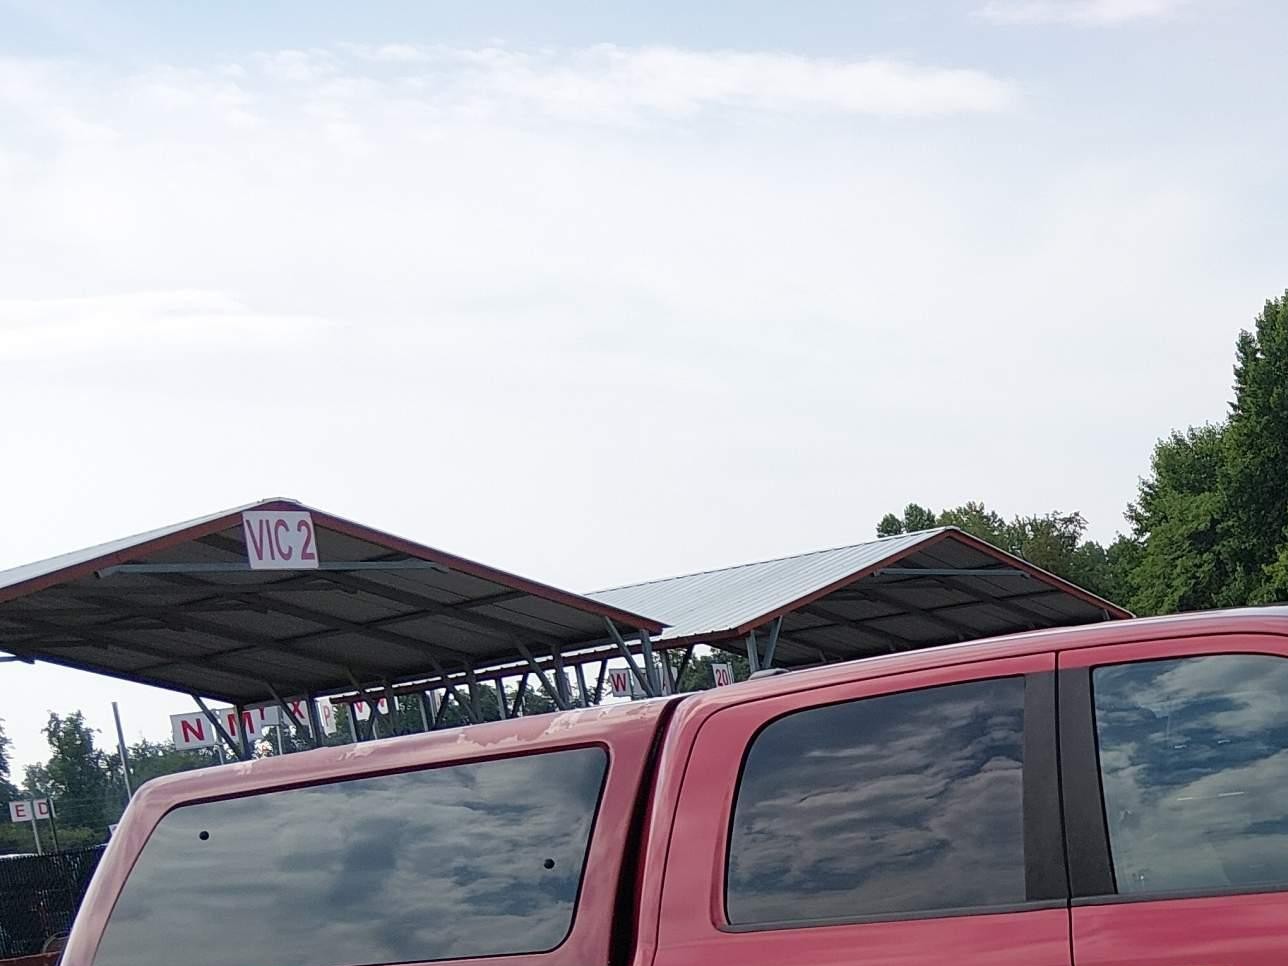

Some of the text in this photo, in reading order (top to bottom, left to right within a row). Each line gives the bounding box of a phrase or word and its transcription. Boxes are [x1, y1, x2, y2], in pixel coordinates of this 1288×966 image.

[245, 519, 316, 561] VIC 2
[611, 672, 627, 692] W
[715, 669, 729, 687] 20
[181, 718, 205, 743] N
[227, 711, 255, 737] M
[15, 804, 27, 817] E
[38, 802, 49, 815] D
